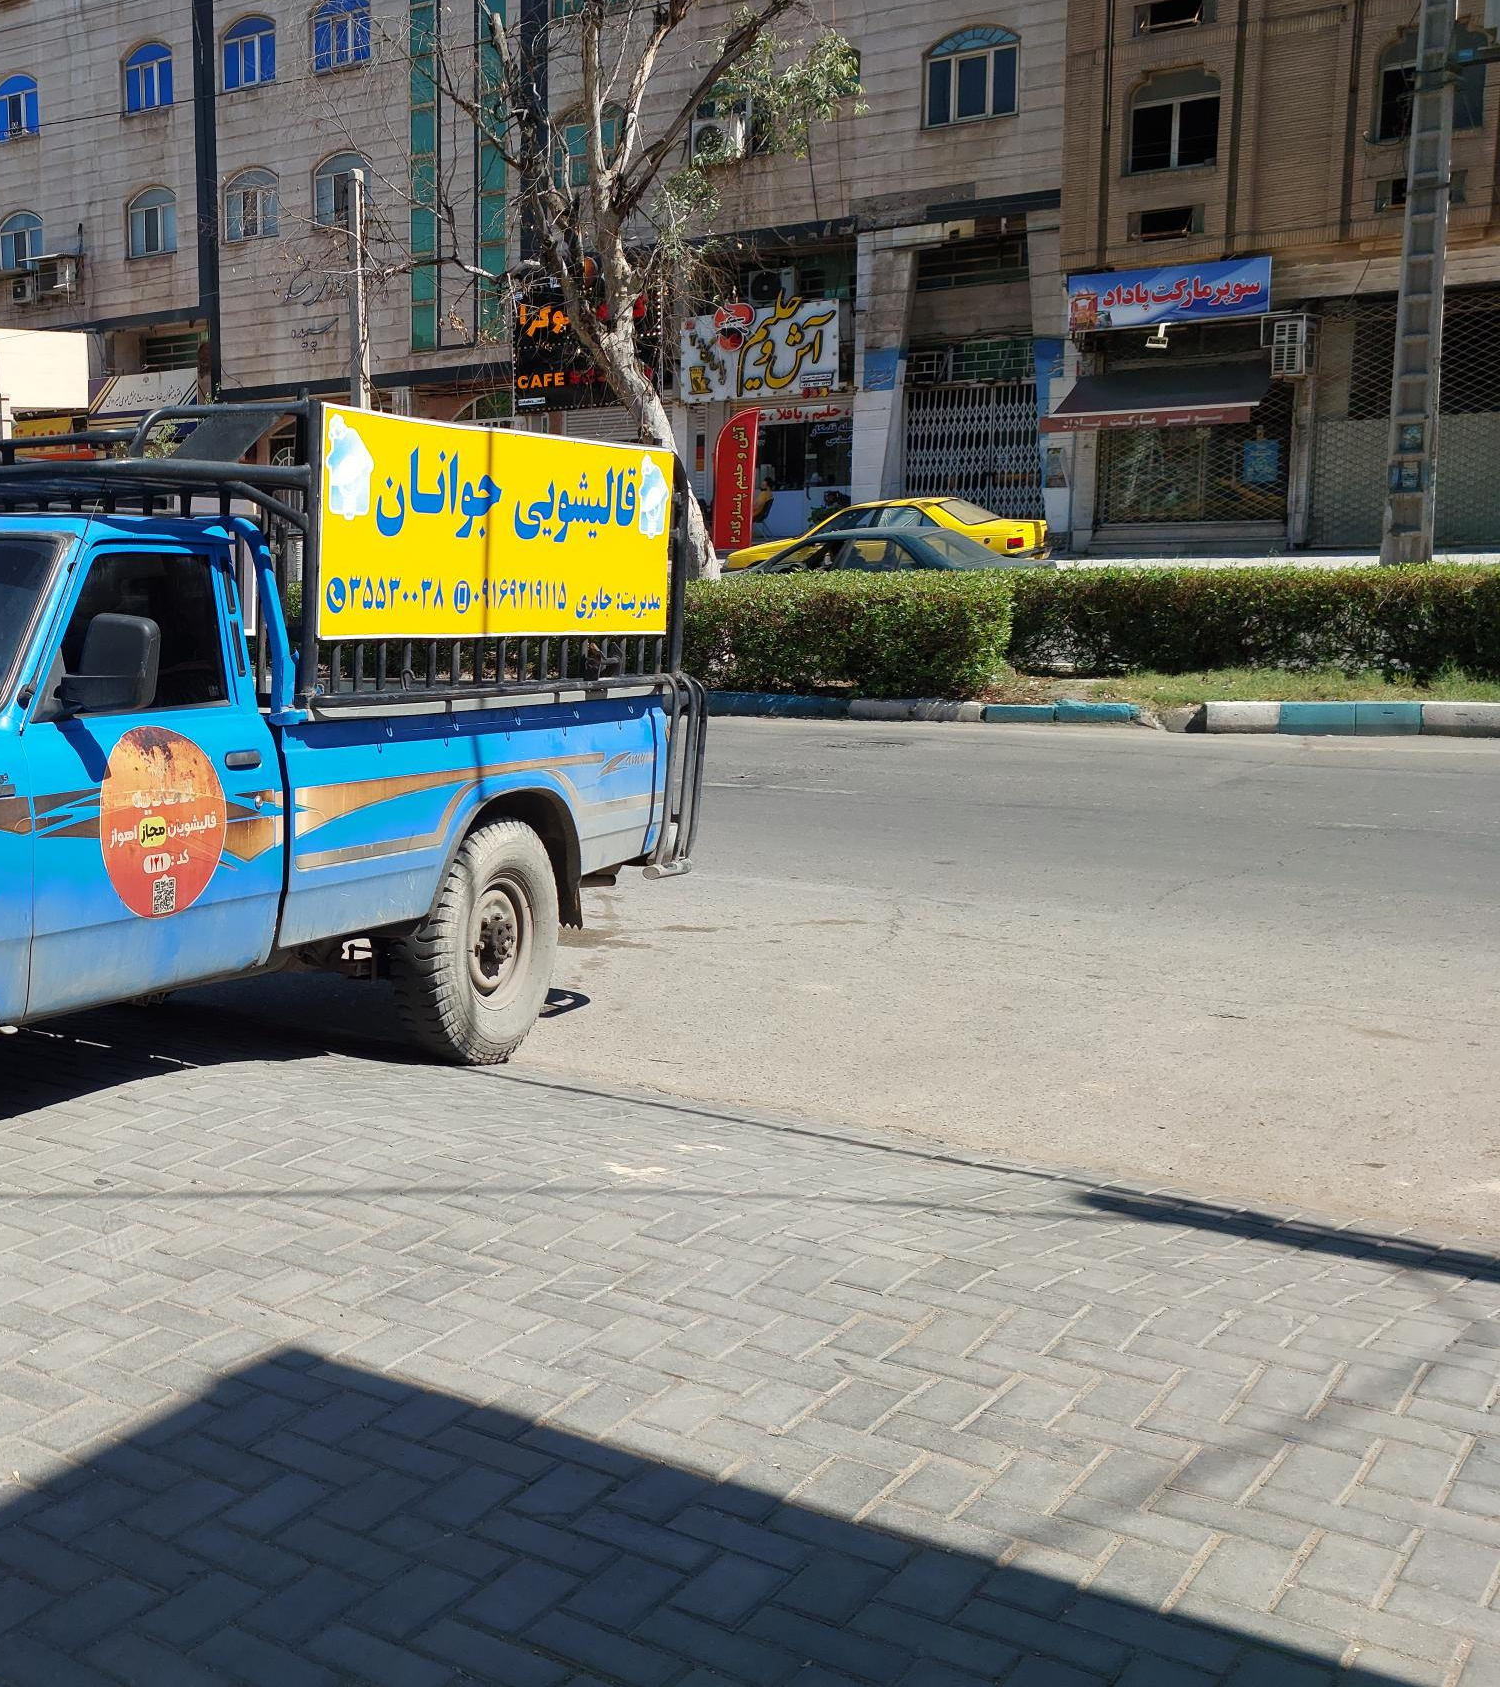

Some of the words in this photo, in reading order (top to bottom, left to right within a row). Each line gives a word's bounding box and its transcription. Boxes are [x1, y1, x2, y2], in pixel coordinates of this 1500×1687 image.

[1102, 281, 1150, 311] پاداد
[737, 287, 802, 398] حلیم
[765, 310, 836, 389] آش
[517, 372, 565, 389] CAFE
[1109, 412, 1157, 429] مارکت
[1164, 412, 1224, 427] سوپر
[732, 426, 750, 449] آش
[733, 463, 748, 490] حلیم
[375, 445, 504, 539] جوانان
[514, 467, 637, 543] قالیشویی
[349, 575, 444, 611] ۳۵۵۳۰۰۳۸
[473, 578, 567, 611] ۰۹۱۶۹۲۱۹۱۱۵
[575, 587, 613, 619] جابری
[110, 825, 138, 849] اهواز
[141, 823, 165, 844] مجاز
[149, 855, 165, 873] ۱۲۱
